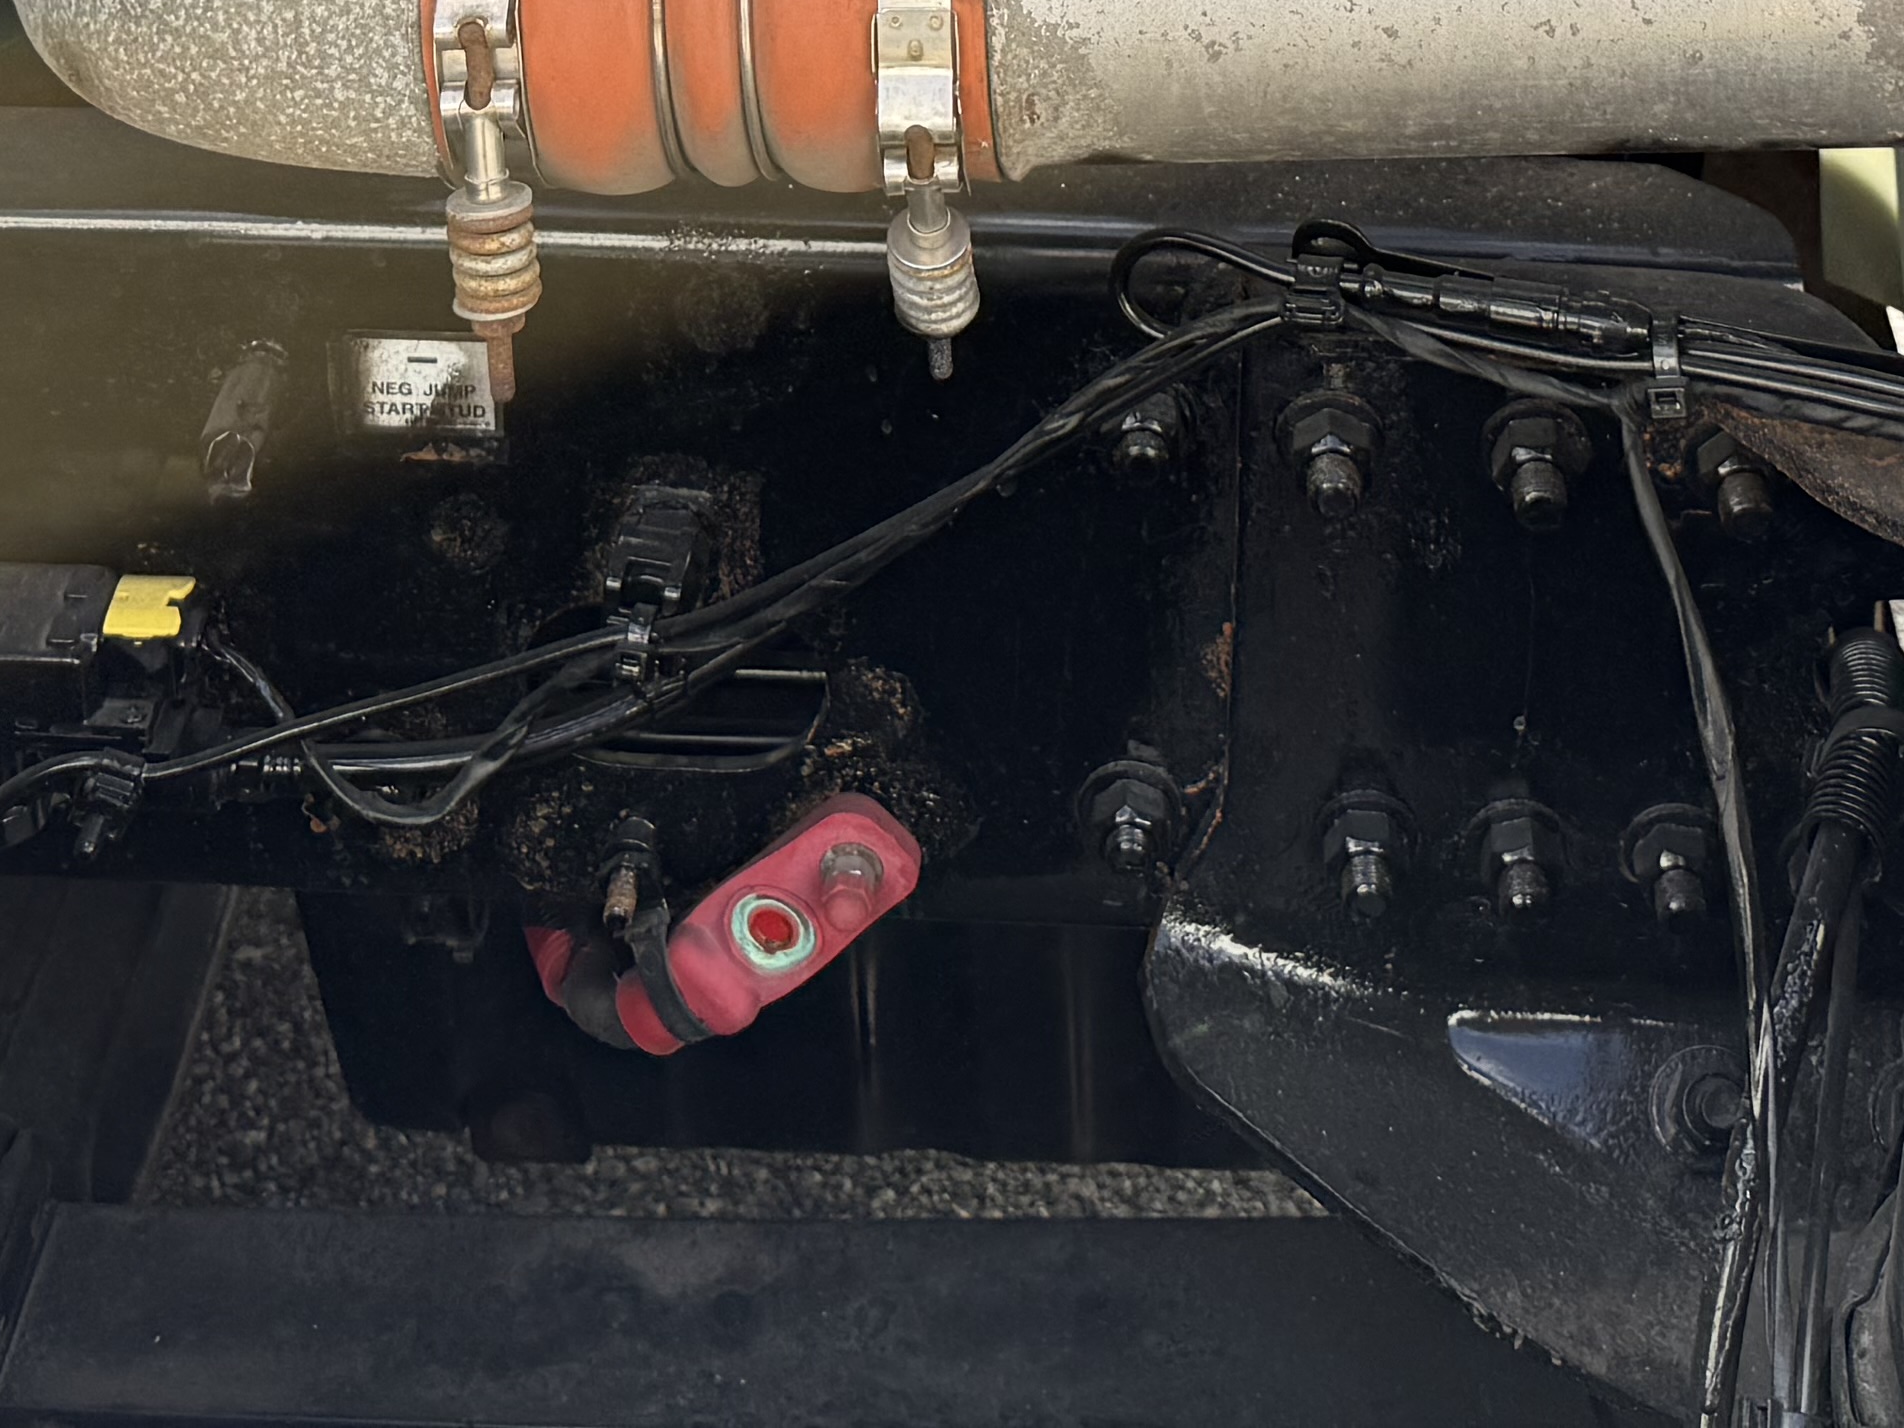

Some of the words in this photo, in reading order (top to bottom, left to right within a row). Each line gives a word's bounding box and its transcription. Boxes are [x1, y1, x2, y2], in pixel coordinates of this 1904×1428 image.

[371, 381, 413, 395] NEG
[363, 401, 428, 417] START
[442, 404, 486, 419] TUD
